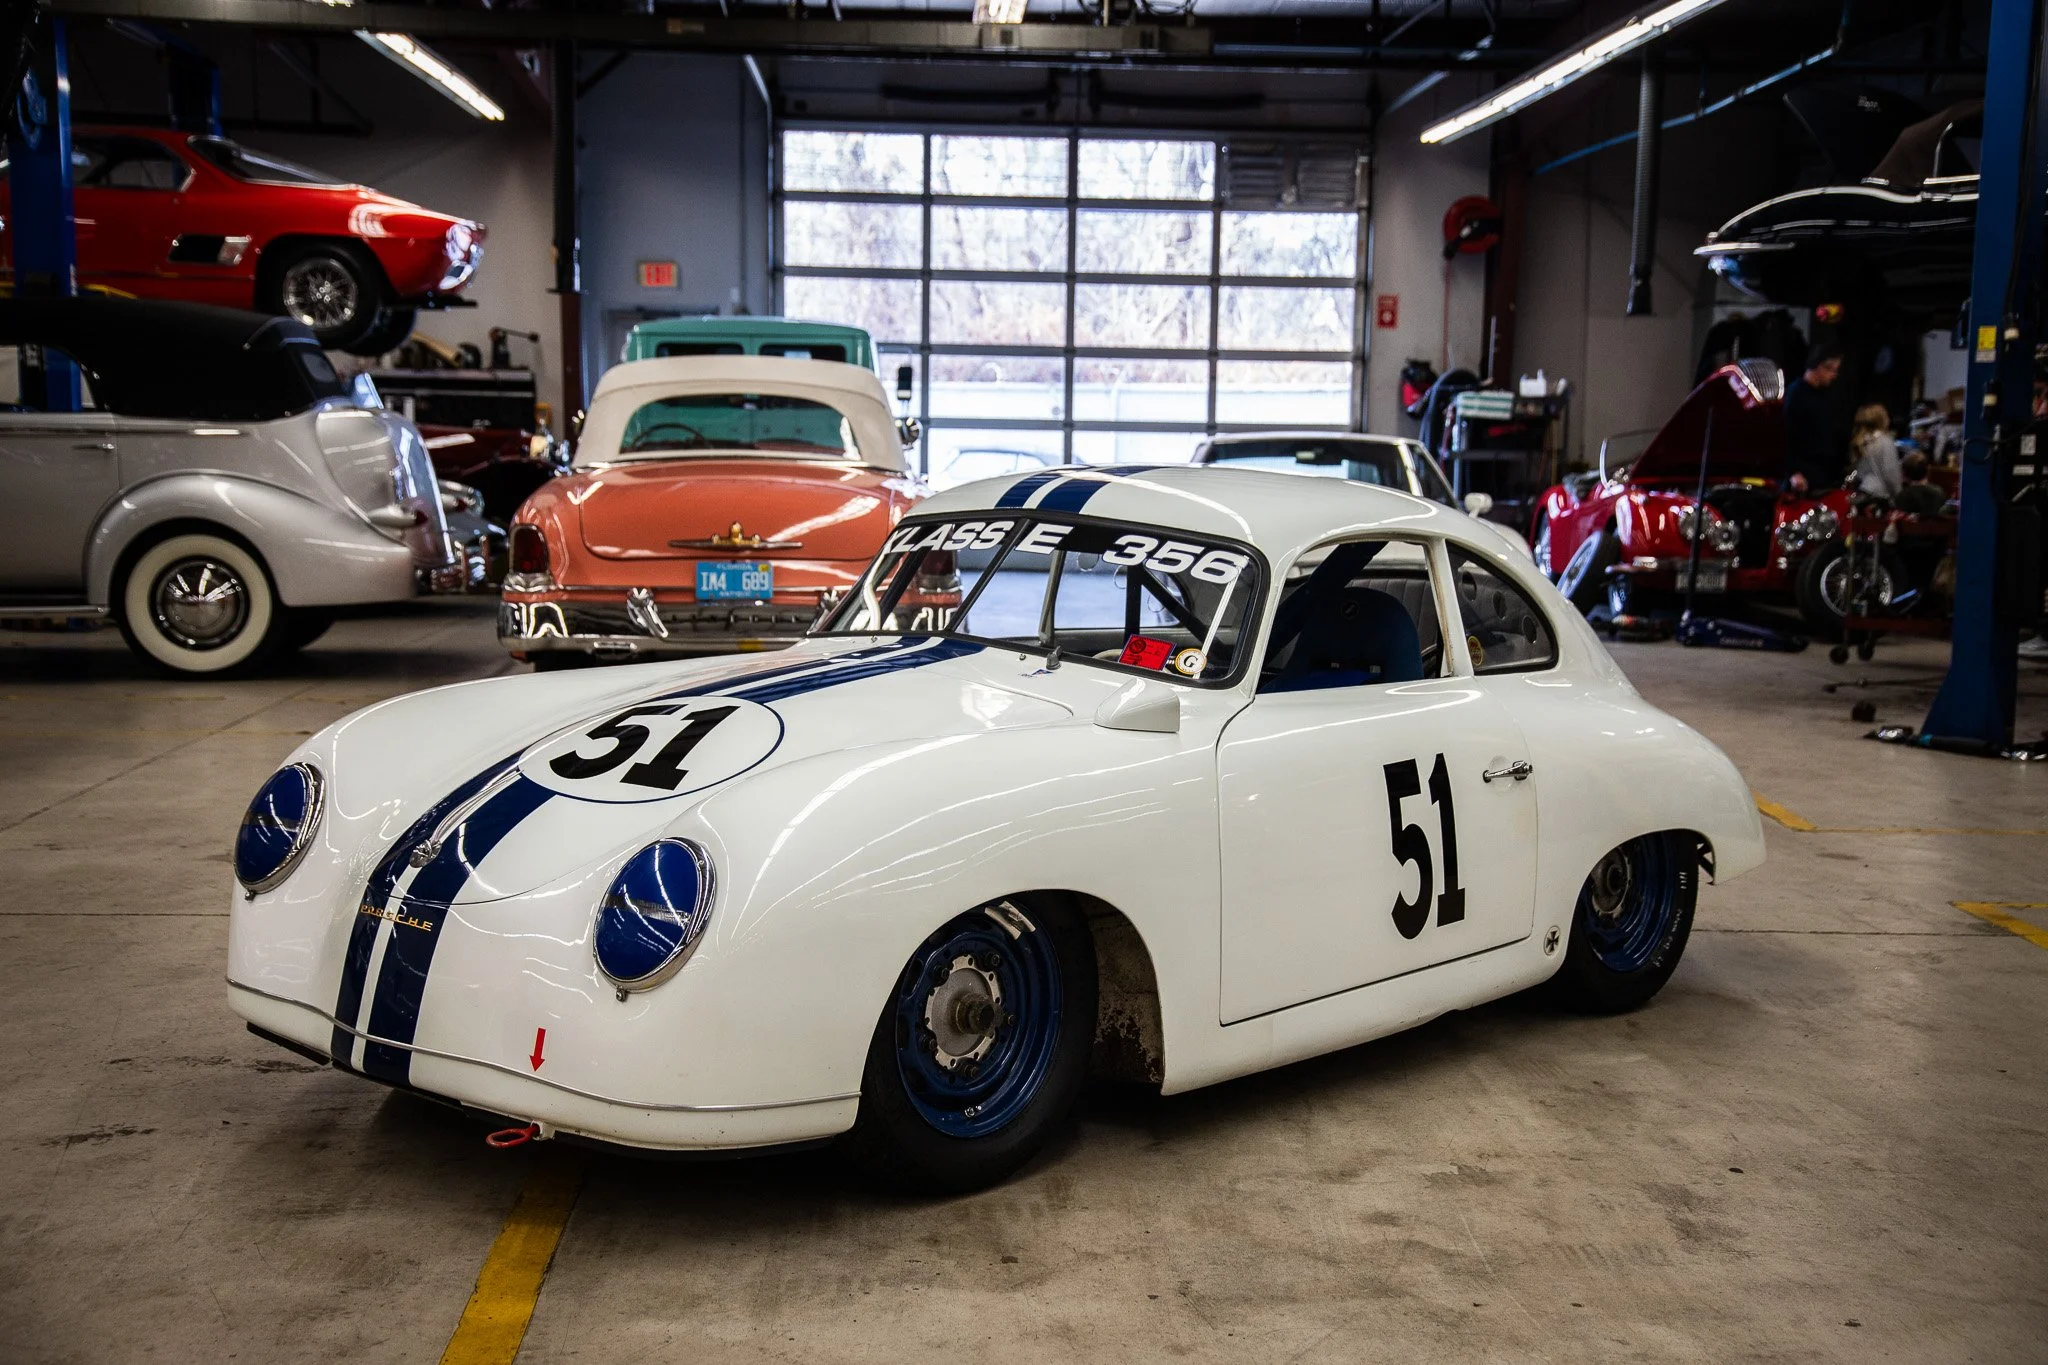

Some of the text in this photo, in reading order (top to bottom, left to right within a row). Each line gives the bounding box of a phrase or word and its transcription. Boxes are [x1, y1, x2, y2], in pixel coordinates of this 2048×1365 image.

[742, 572, 769, 591] 689
[1014, 523, 1075, 555] E
[1102, 534, 1249, 584] 356
[1183, 655, 1198, 668] G
[549, 703, 741, 791] 51
[1383, 753, 1465, 940] 51
